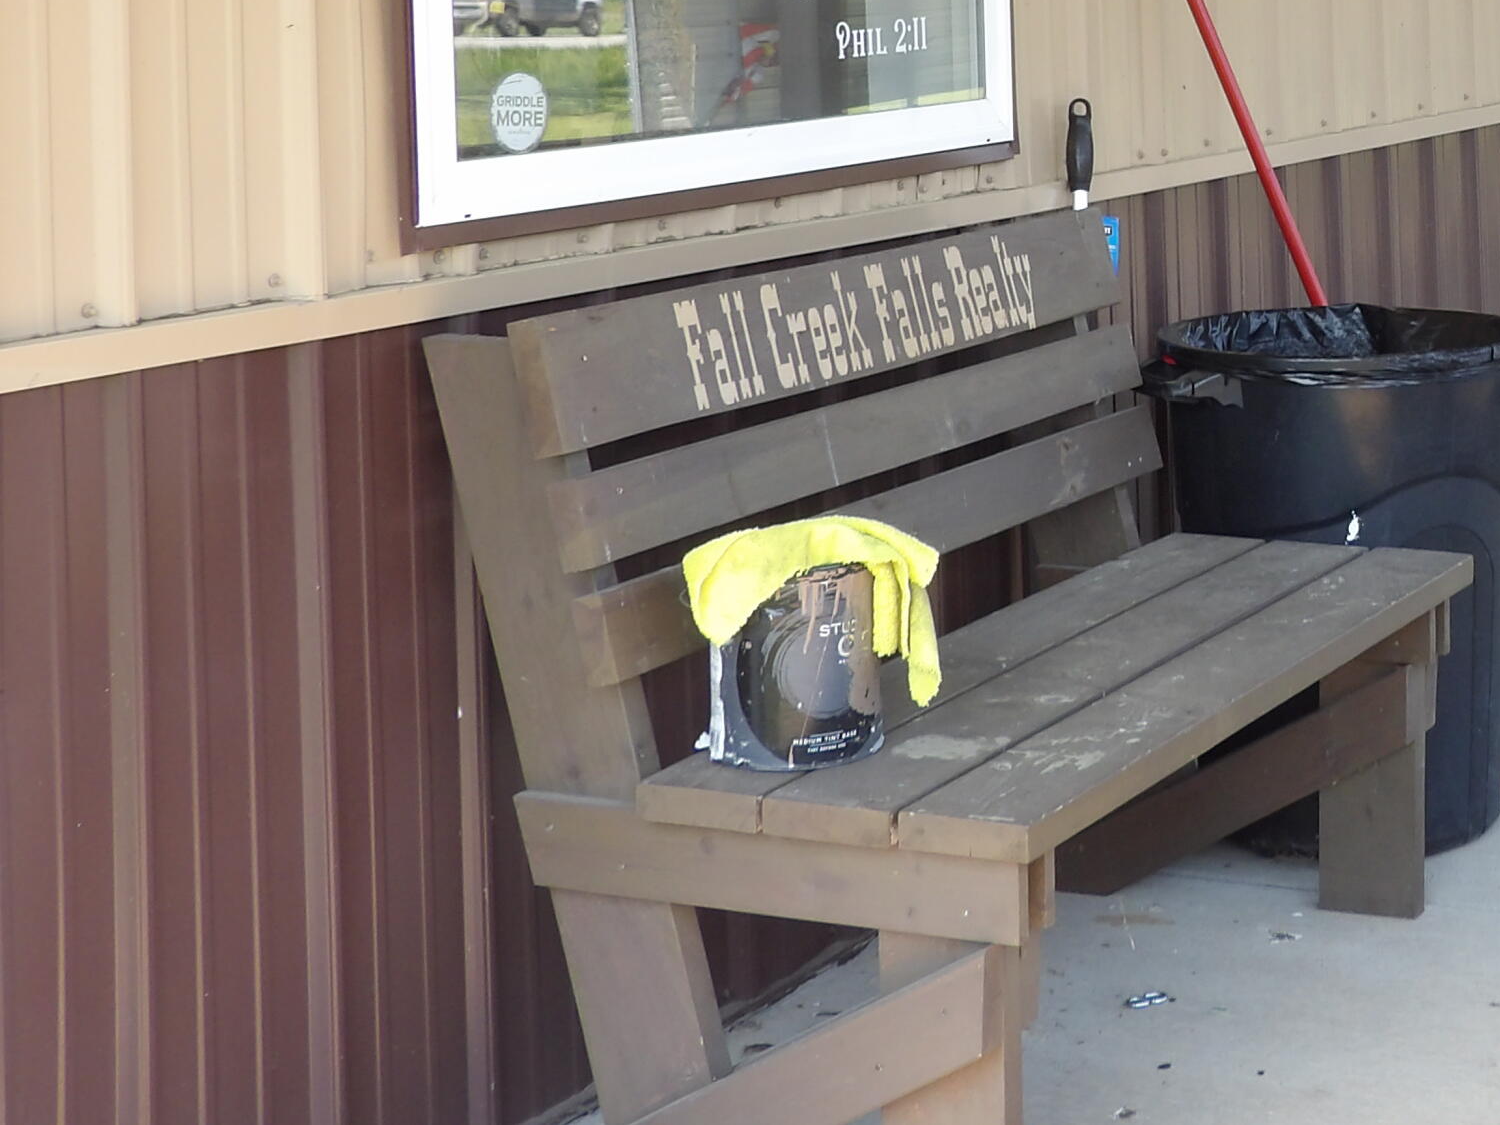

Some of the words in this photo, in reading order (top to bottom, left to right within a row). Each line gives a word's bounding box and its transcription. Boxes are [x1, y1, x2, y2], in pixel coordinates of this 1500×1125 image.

[894, 16, 927, 54] 2:11
[496, 95, 544, 108] GRIDDLE
[496, 110, 543, 127] MORE
[673, 290, 766, 411] Fall
[760, 271, 874, 389] Creek
[863, 254, 956, 364] Falls
[943, 234, 1036, 341] Realty
